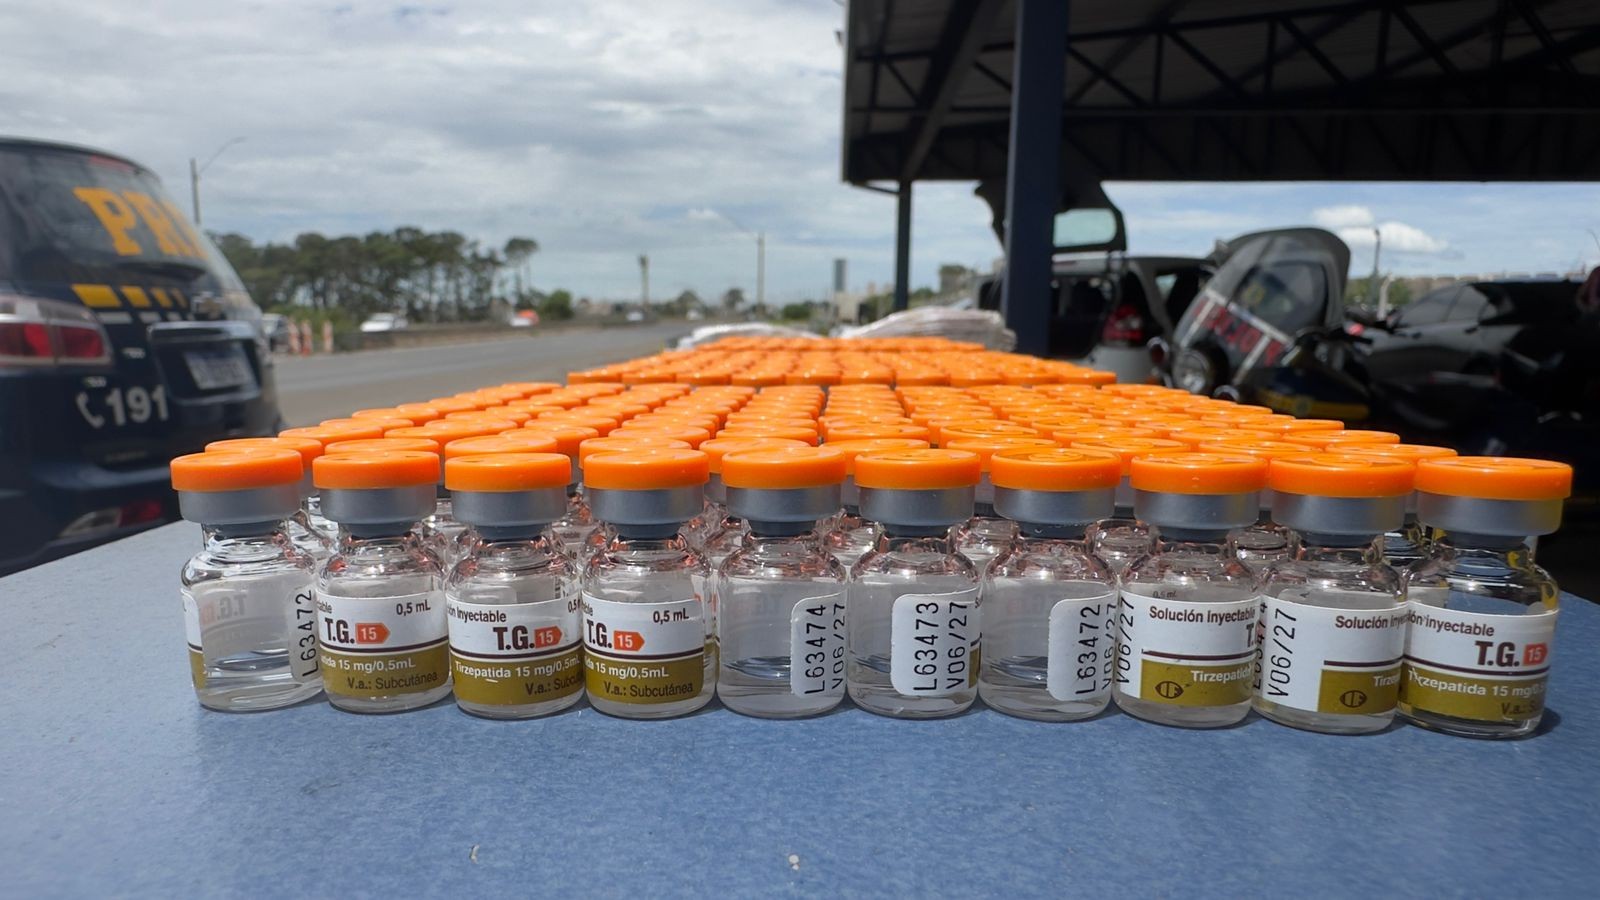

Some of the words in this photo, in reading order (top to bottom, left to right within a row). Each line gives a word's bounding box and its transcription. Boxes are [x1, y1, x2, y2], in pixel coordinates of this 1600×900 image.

[105, 383, 168, 426] 191
[396, 602, 413, 616] 0,5
[416, 599, 431, 612] mL
[653, 610, 670, 625] 0,5
[673, 608, 689, 621] mL
[1149, 605, 1203, 623] Solución
[324, 617, 355, 644] T.G.
[1335, 615, 1388, 629] Solución
[1426, 614, 1495, 637] inyectable
[295, 590, 319, 677] L63472
[361, 627, 377, 641] 15
[493, 625, 535, 651] T.G.
[539, 631, 553, 644] 15
[586, 619, 613, 649] T.G.
[617, 634, 633, 648] 15
[1115, 596, 1135, 684] V06/27
[804, 604, 826, 694] L63474
[831, 603, 845, 689] V06/27
[913, 602, 939, 690] L63473
[945, 602, 968, 689] V06/27
[1075, 604, 1101, 694] L63472
[1267, 608, 1297, 697] V06/27
[1475, 640, 1520, 667] T.G.
[1528, 647, 1542, 661] 15
[338, 659, 350, 670] 15
[455, 661, 511, 678] Tirzepatida
[515, 666, 531, 677] 15
[595, 661, 606, 674] 15
[375, 671, 438, 689] Subcutánea
[630, 682, 693, 697] Subcutánea
[1492, 685, 1508, 697] 15
